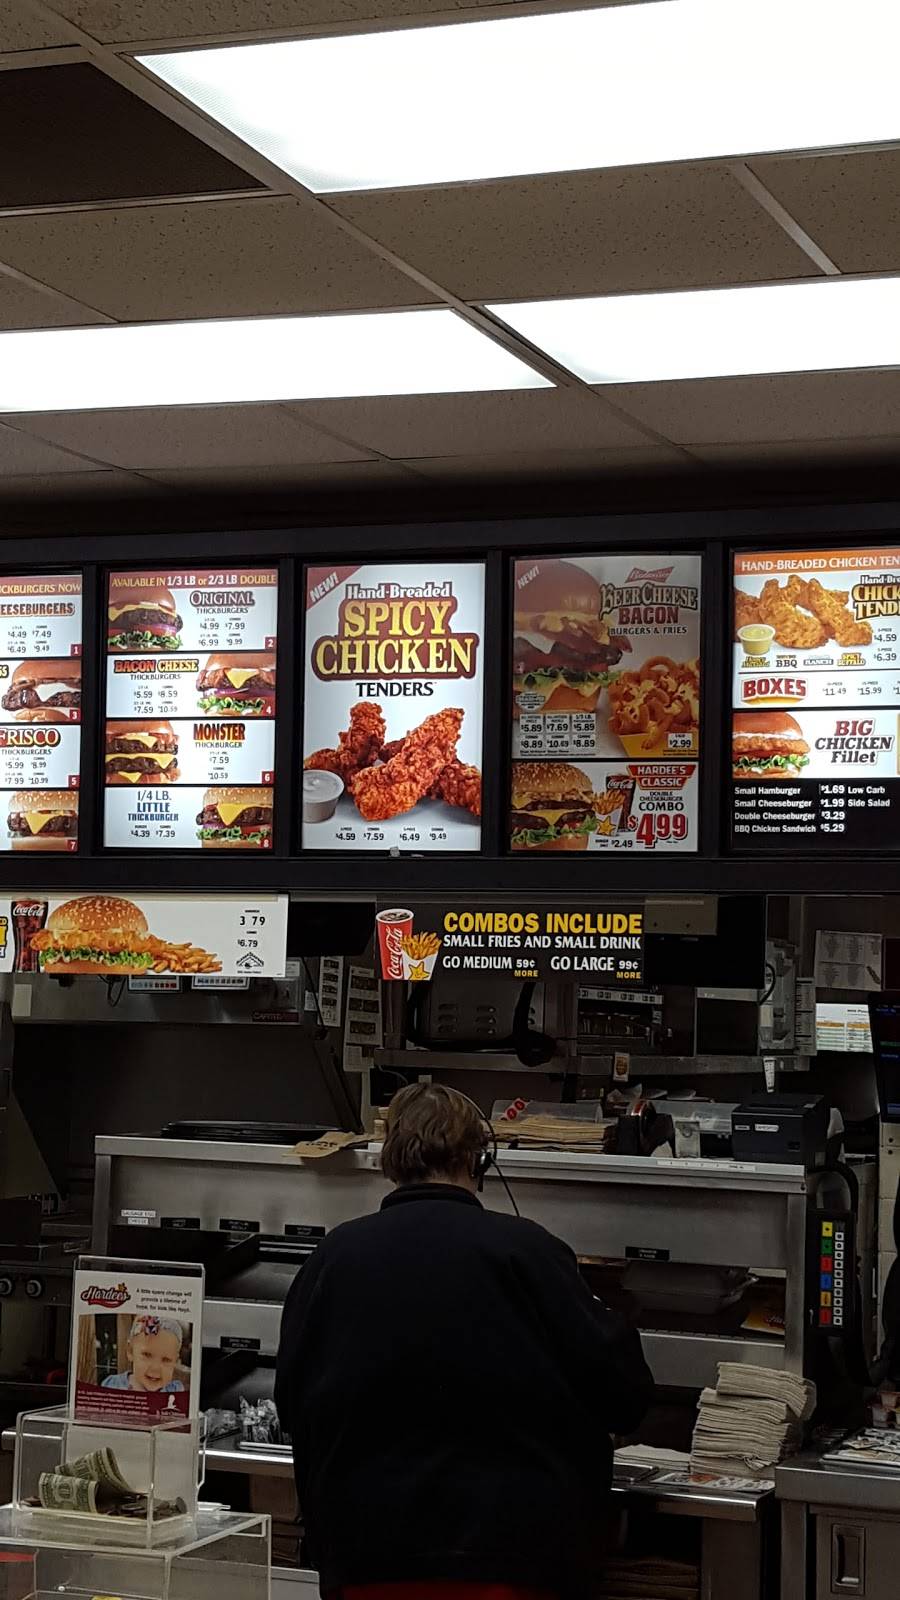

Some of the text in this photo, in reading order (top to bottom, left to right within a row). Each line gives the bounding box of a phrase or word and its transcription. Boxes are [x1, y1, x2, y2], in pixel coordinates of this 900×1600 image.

[741, 559, 827, 571] HAND-BREADED
[829, 556, 877, 568] CHICKEN
[112, 577, 155, 587] AVAILABLE
[156, 577, 166, 586] IN
[167, 576, 182, 586] 1/3
[184, 576, 196, 585] LB
[208, 575, 223, 585] 2/3
[226, 574, 238, 584] LB
[240, 574, 276, 585] DOUBLE
[309, 572, 339, 602] NEW!
[58, 583, 81, 593] NOW
[347, 583, 450, 599] Hand-Breaded
[190, 590, 255, 607] ORIGINAL
[343, 600, 452, 638] SPICY
[617, 606, 679, 625] BACON
[610, 627, 651, 635] BURGERS
[663, 626, 688, 634] FRIES
[314, 638, 475, 675] CHICKEN
[114, 659, 199, 673] BACON CHEESE
[775, 659, 798, 668] BBQ
[356, 682, 434, 697] TENDERS
[743, 678, 807, 698] BOXES
[193, 723, 246, 740] MONSTER
[835, 720, 873, 736] BIG
[0, 728, 61, 747] FRISCO
[815, 737, 893, 750] CHICKEN
[831, 750, 876, 764] Fillet
[641, 777, 682, 787] CLASSIC
[136, 791, 153, 801] 1/4
[734, 787, 801, 796] Small Hamburger
[866, 786, 886, 794] Carb
[136, 802, 171, 813] LITTLE
[638, 802, 685, 812] COMBO
[734, 800, 812, 809] Small Cheeseburger
[848, 798, 891, 807] Side Salad
[127, 813, 179, 822] THICKBURGER
[734, 811, 816, 821] Double Cheeseburger
[751, 824, 781, 832] Chicken
[782, 824, 817, 833] Sandwich
[443, 912, 642, 934] COMBOS INCLUDE
[443, 935, 641, 950] SMALL FRIES AND SMALL DRINK
[442, 956, 460, 969] GO
[463, 956, 513, 969] MEDIUM
[551, 957, 570, 970] GO
[574, 957, 614, 971] LARGE
